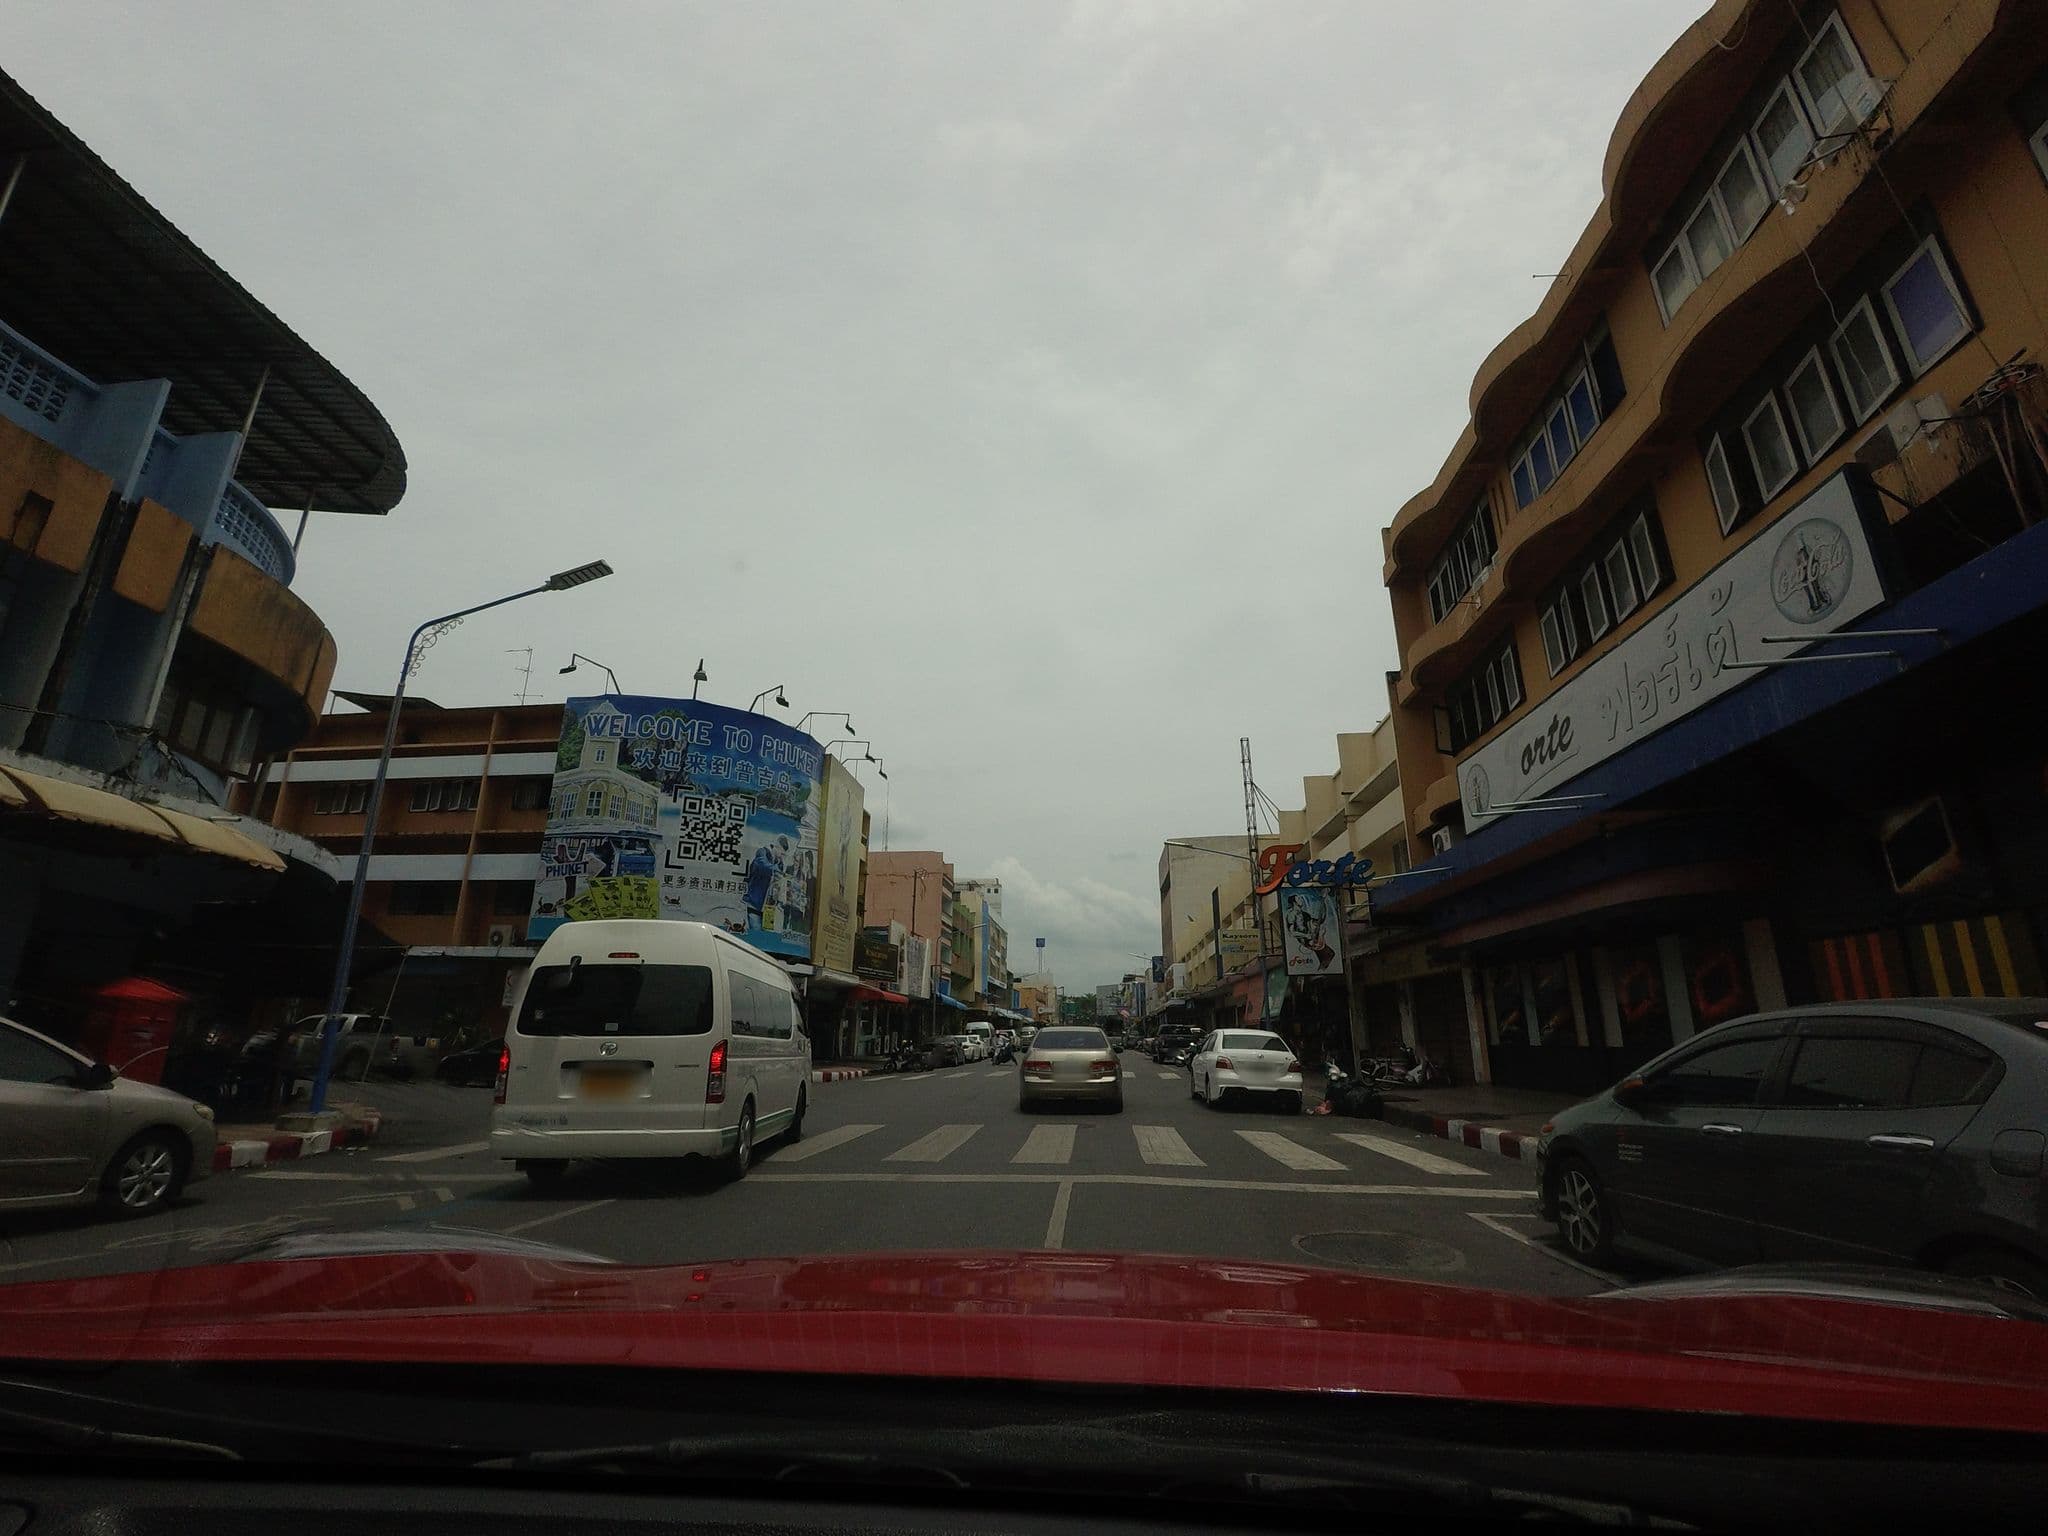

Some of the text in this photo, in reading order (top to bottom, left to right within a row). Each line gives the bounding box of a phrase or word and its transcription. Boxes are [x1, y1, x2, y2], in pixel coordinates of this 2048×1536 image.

[1601, 580, 1740, 742] ฟอร์เต้
[585, 713, 819, 778] WELCOME TO PHUKET
[631, 748, 791, 793] 欢迎来到普吉岛
[545, 861, 590, 878] PHUKET
[662, 874, 748, 894] 更多资讯请扫码
[1255, 843, 1376, 895] Forte
